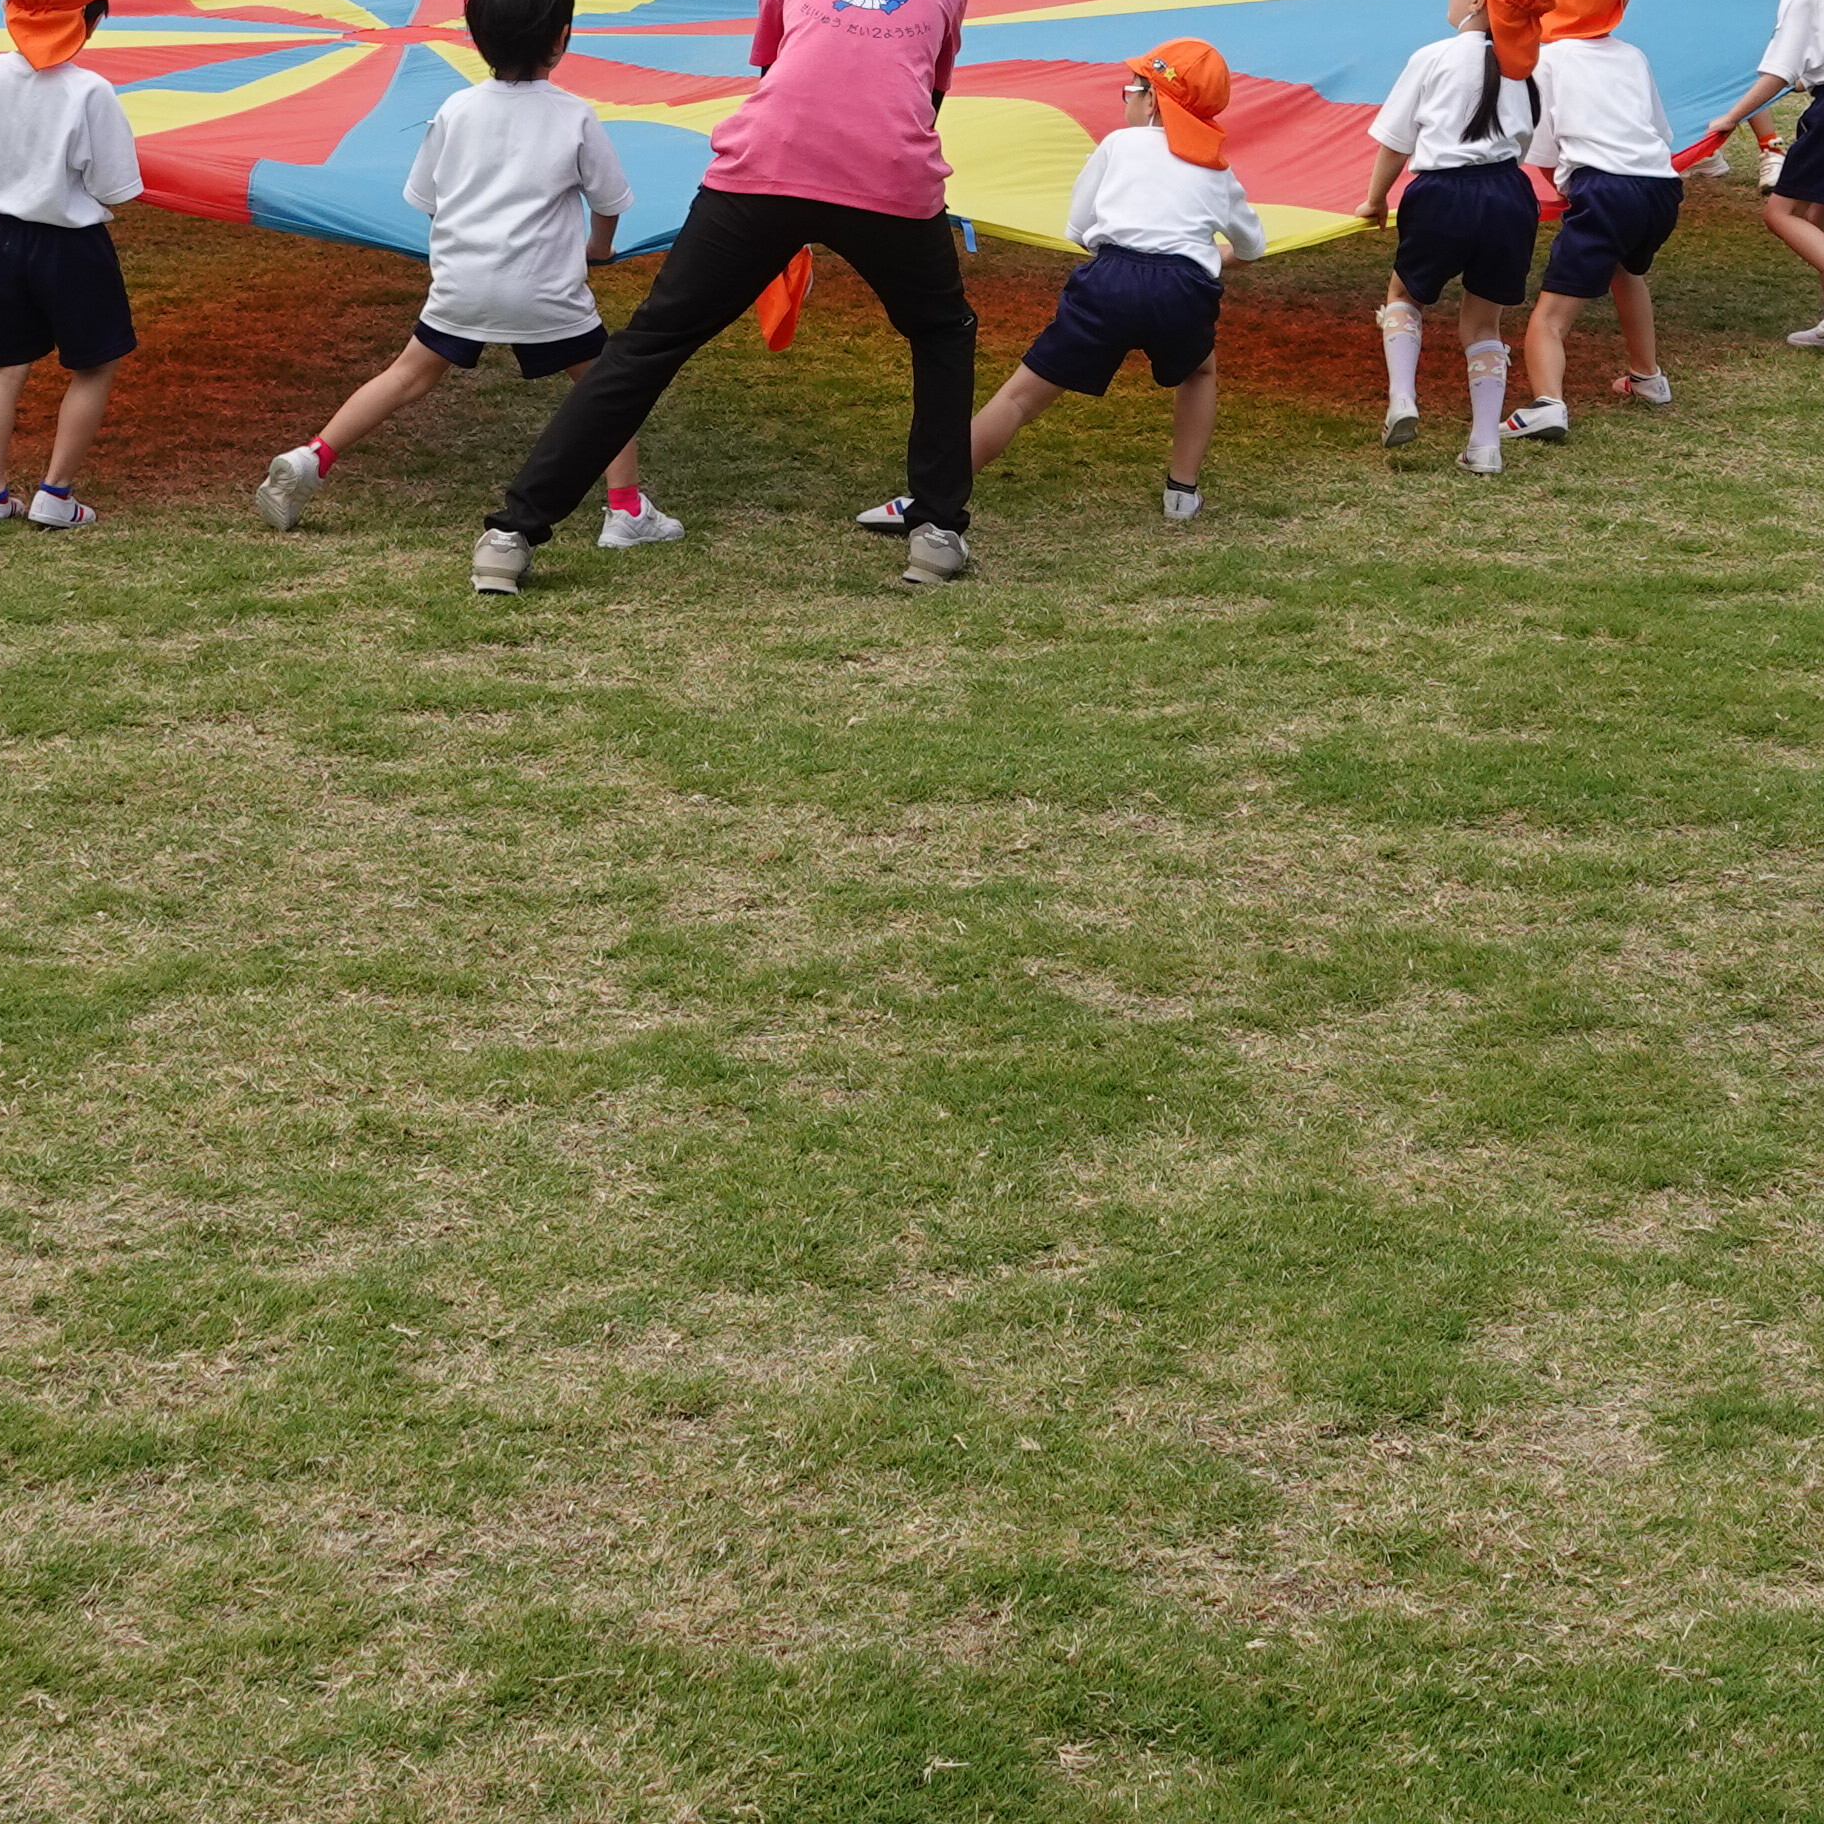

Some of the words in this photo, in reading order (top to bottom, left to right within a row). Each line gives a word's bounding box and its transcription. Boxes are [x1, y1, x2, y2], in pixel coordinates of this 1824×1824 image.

[800, 2, 842, 28] せいりゅう
[846, 20, 932, 39] だい2ようちえん
